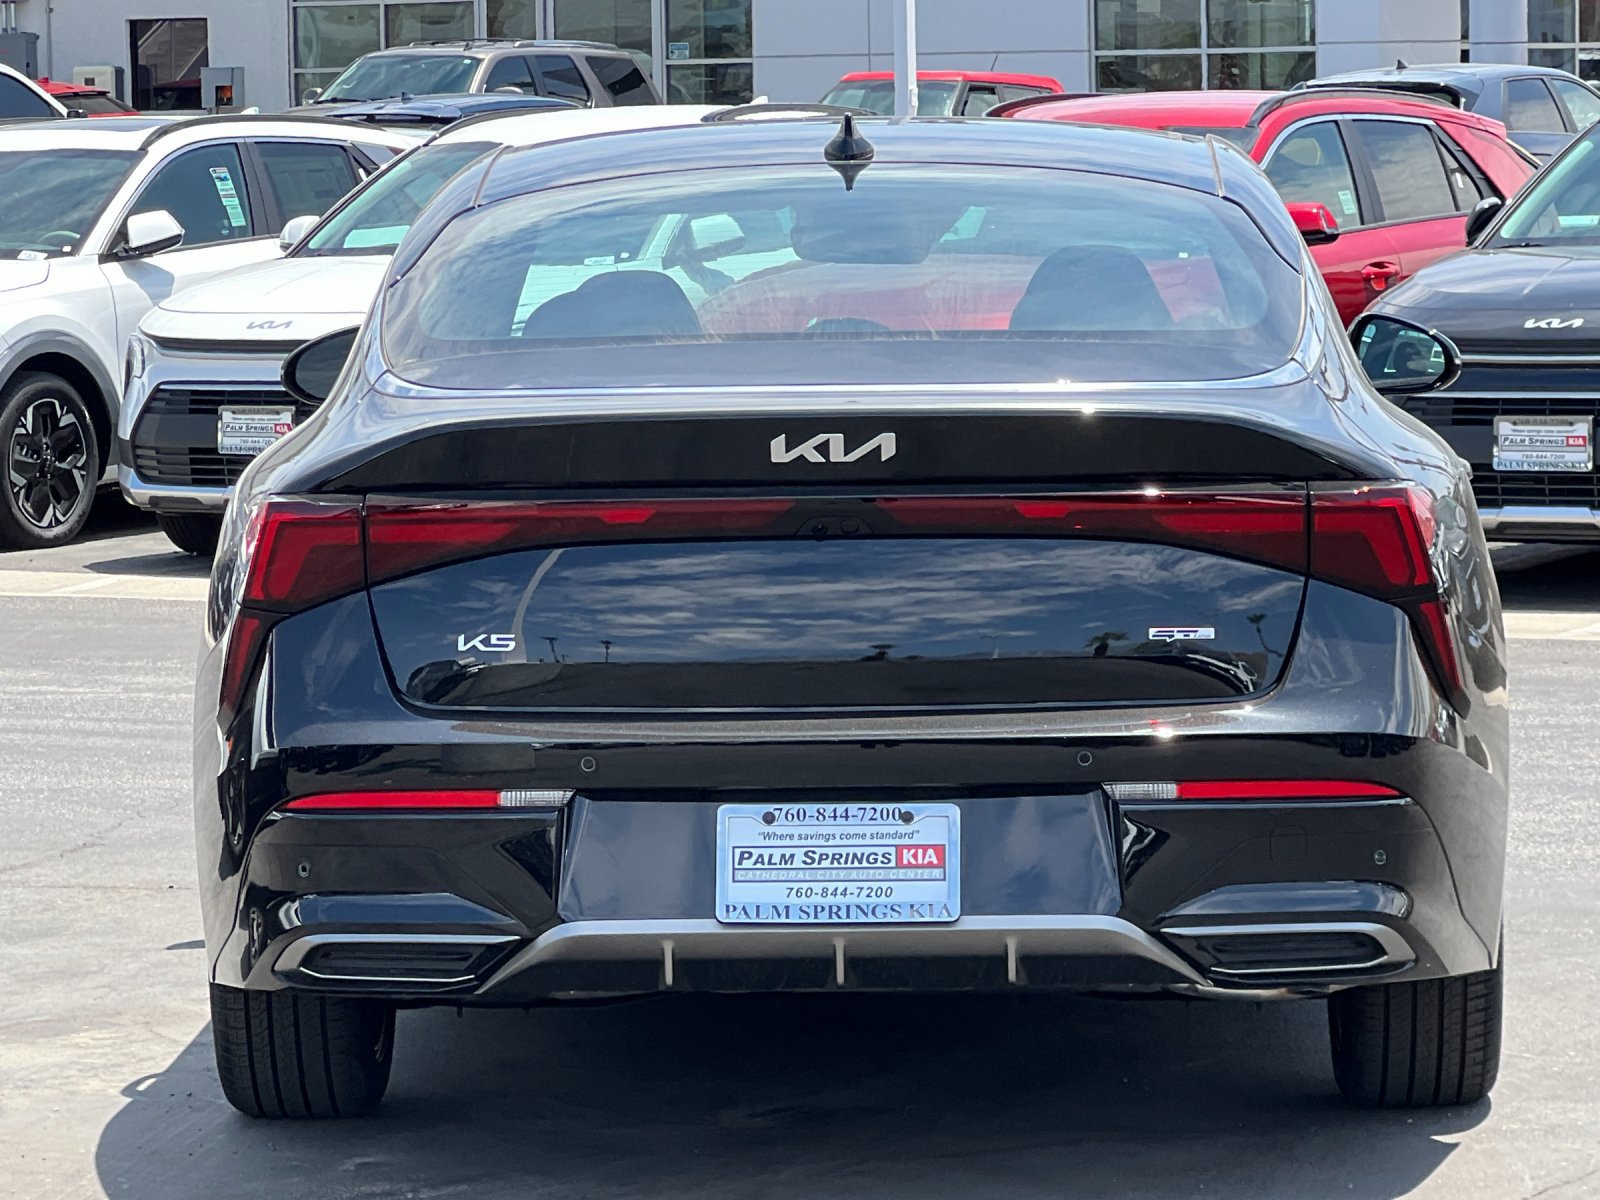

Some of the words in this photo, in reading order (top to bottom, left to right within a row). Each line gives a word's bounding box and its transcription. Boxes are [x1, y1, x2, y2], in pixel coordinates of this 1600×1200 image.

[245, 424, 274, 432] SPRINGS
[770, 432, 896, 463] KIA
[1503, 436, 1525, 444] PALM
[1528, 437, 1565, 445] SPRINGS
[1568, 437, 1584, 446] KIA
[457, 633, 516, 652] K5
[772, 806, 901, 822] 760-844-7200
[797, 831, 837, 842] savings
[839, 832, 867, 841] come
[737, 850, 795, 866] PALM
[802, 850, 893, 866] SPRINGS
[902, 848, 938, 864] KIA
[737, 871, 812, 880] CATHEDRAL
[817, 870, 846, 880] CITY
[851, 870, 886, 880] AUTO
[891, 870, 941, 879] CENTER
[786, 887, 894, 899] 760-844-7200
[725, 904, 791, 920] PALM
[798, 904, 902, 920] SPRINGS
[909, 903, 953, 919] KIA
